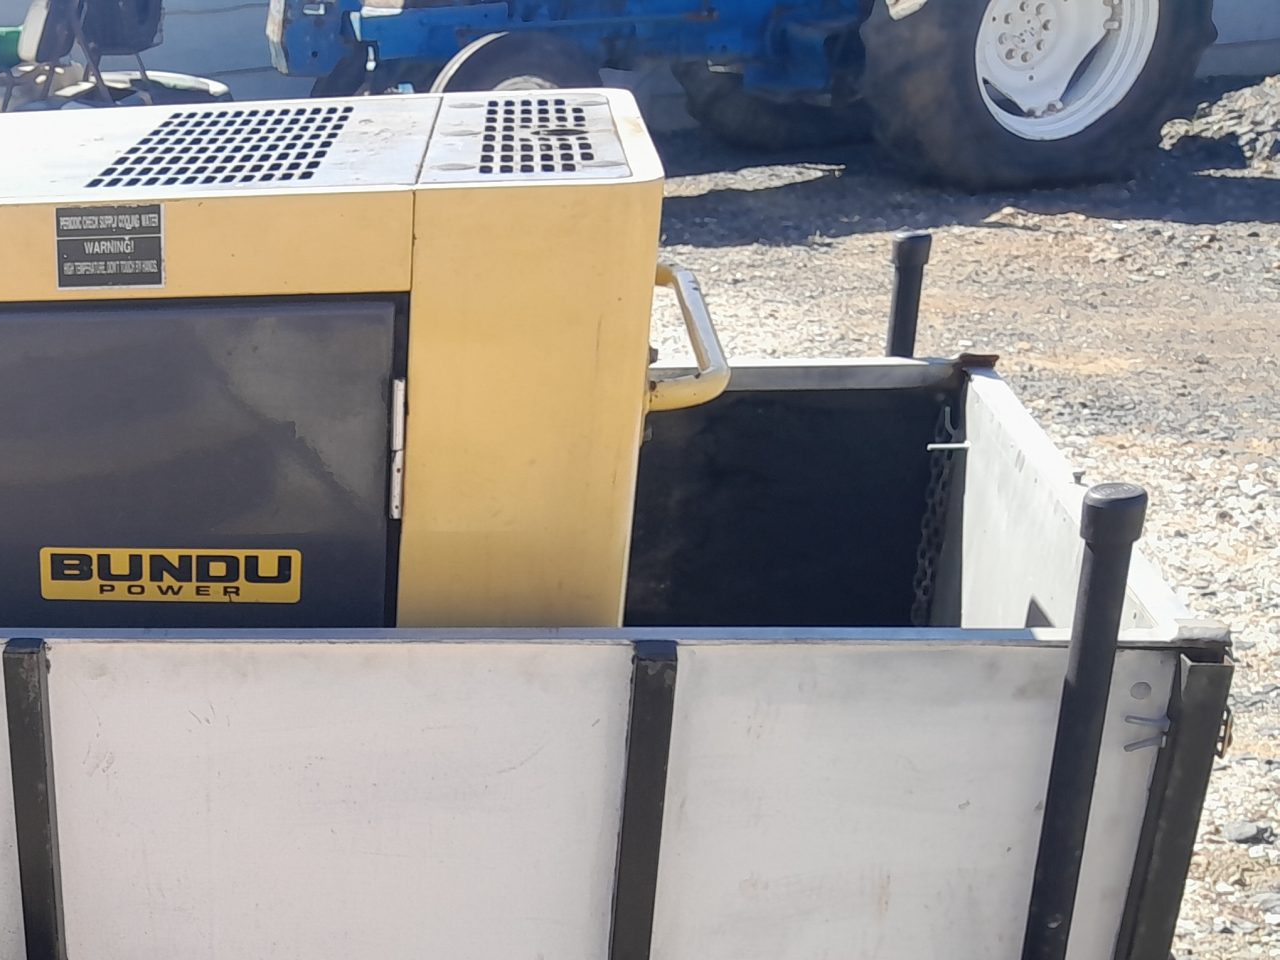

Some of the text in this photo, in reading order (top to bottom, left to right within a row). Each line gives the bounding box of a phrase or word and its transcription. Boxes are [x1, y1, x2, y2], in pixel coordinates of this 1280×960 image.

[84, 240, 135, 254] WARNING!
[50, 553, 292, 584] BUNDU
[99, 584, 241, 597] POWER
